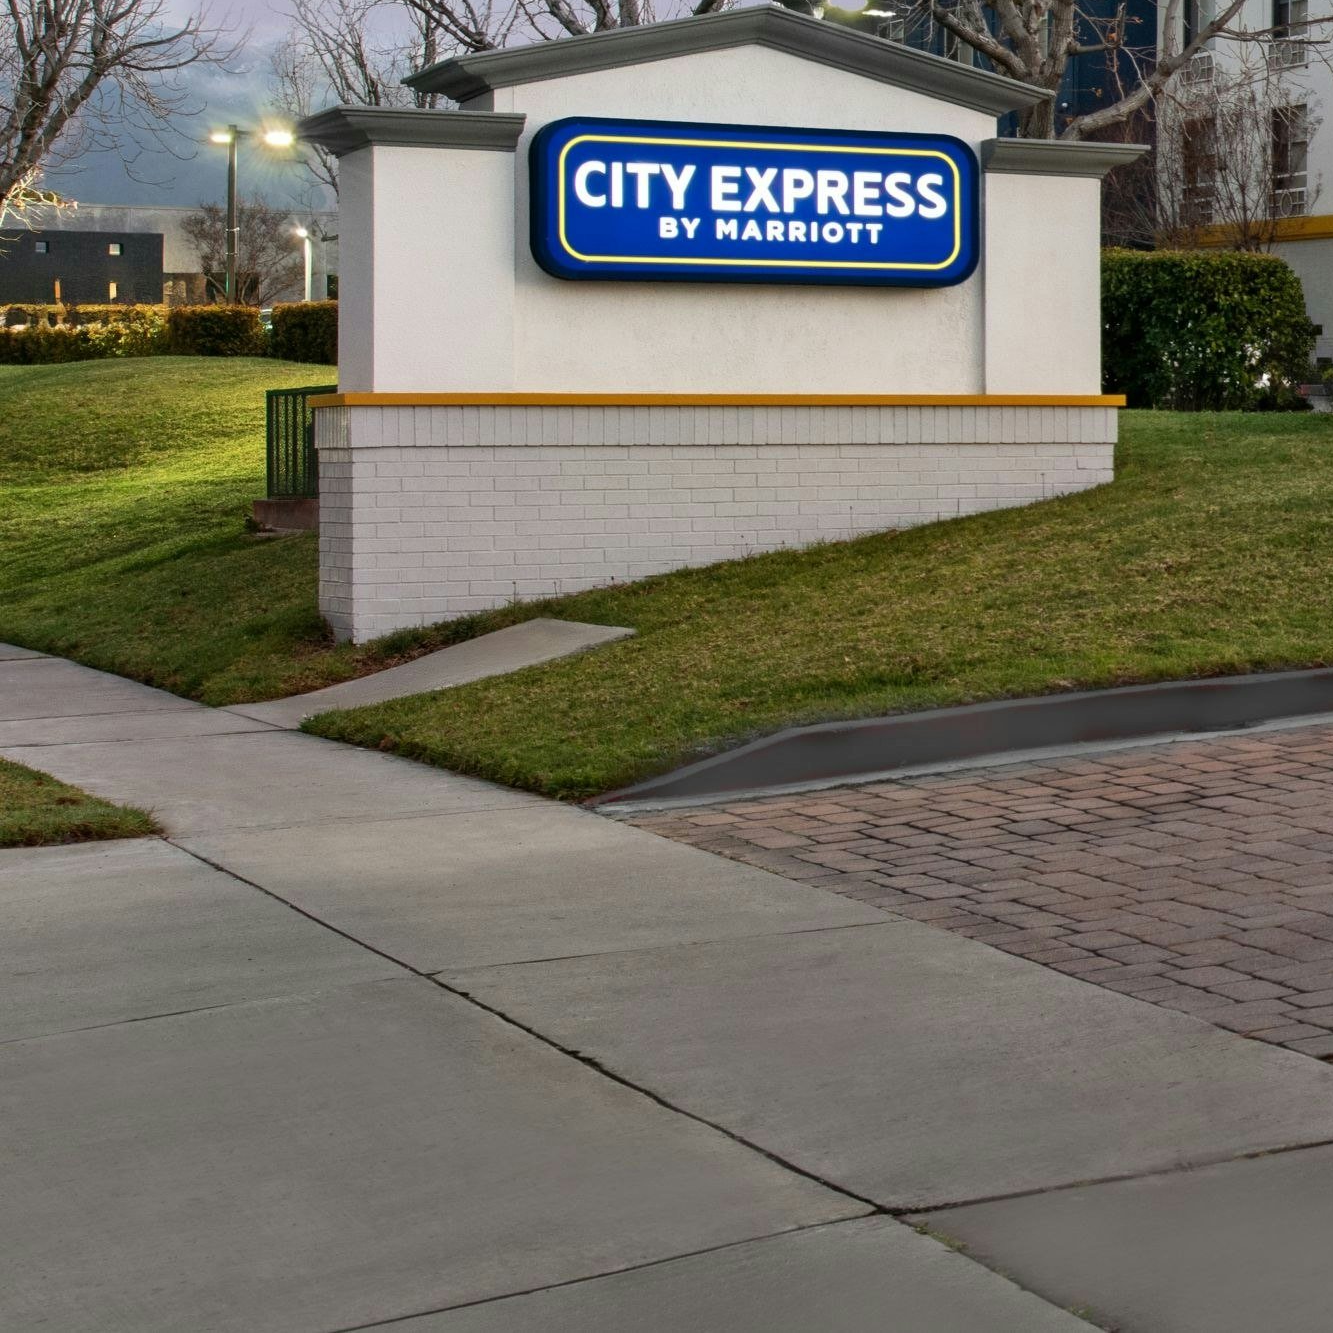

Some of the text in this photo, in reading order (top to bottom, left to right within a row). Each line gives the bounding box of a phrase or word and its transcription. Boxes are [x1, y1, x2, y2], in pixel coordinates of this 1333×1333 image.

[573, 160, 948, 219] CITY EXPRESS
[659, 216, 883, 244] BY MARRIOTT
